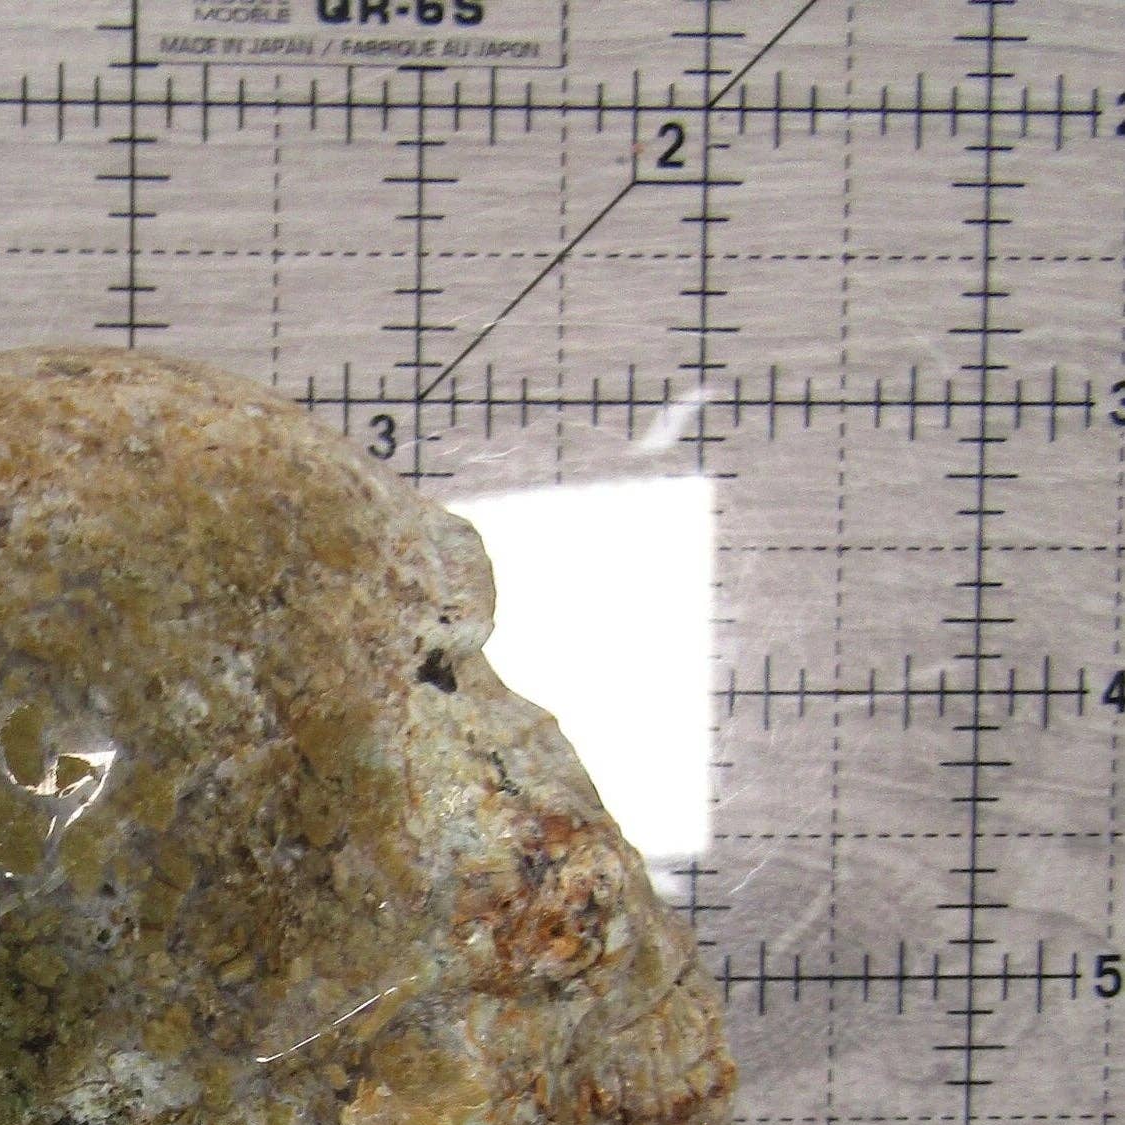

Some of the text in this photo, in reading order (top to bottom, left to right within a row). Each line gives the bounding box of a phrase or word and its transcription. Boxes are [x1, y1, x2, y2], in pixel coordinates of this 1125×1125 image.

[317, 0, 483, 26] QR-6S
[160, 36, 218, 54] MADE
[222, 37, 244, 54] IN
[249, 37, 313, 56] JAPAN
[443, 40, 470, 58] AU
[477, 40, 539, 58] JAPON
[656, 122, 686, 168] 2
[368, 414, 396, 460] 3
[1102, 670, 1125, 714] 4
[1095, 954, 1123, 998] 5
